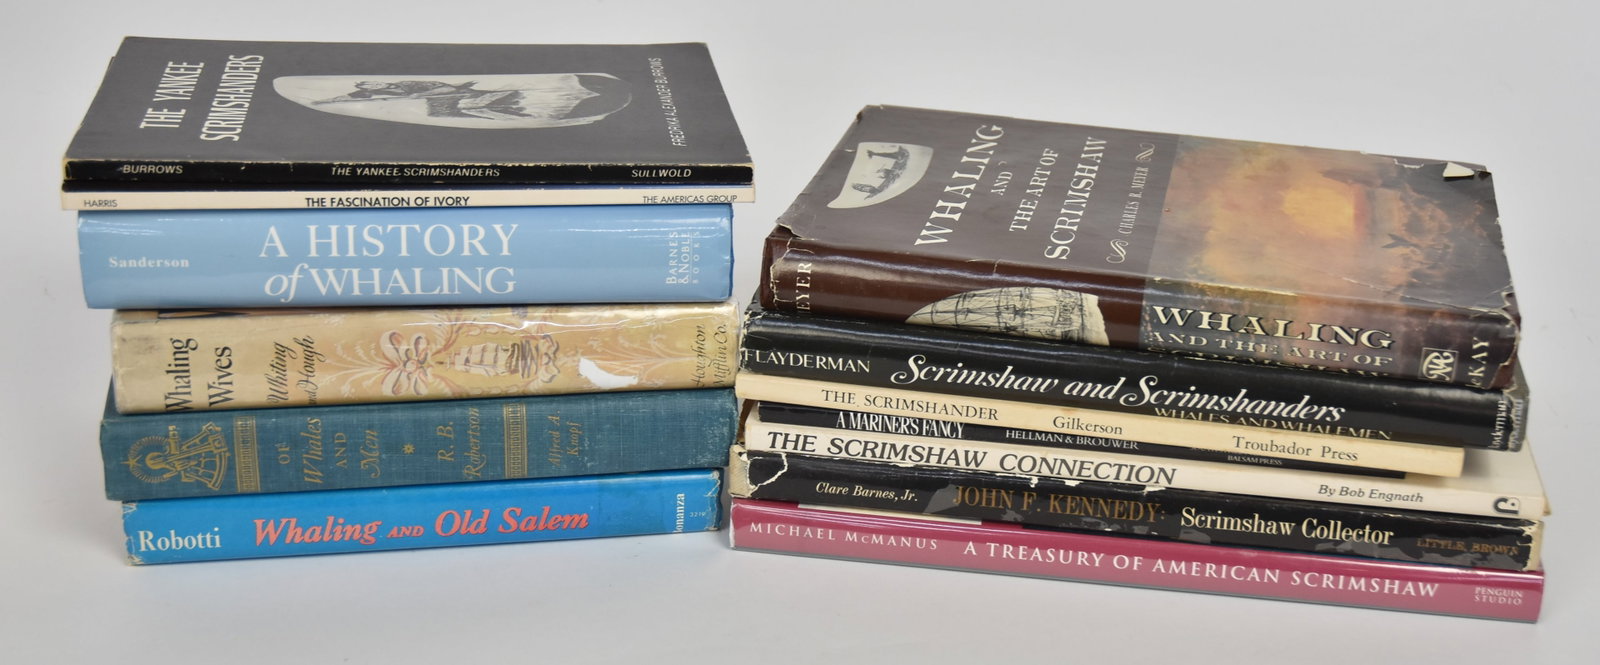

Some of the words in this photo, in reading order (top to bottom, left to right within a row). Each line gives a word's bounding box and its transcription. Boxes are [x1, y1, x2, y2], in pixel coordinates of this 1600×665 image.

[153, 61, 205, 102] YANKEE
[648, 57, 668, 84] BURROWS
[200, 55, 264, 141] SCRIMSHANDERS
[656, 85, 677, 117] ALEXANDER
[139, 107, 187, 129] THE
[666, 117, 687, 147] FREDRIKA
[121, 164, 184, 175] BURROWS
[331, 166, 353, 176] THE
[356, 167, 399, 177] YANKEE
[404, 168, 501, 178] SCRIMSHANDERS
[631, 168, 692, 178] SULLWOLD
[914, 125, 1004, 246] WHALING
[990, 171, 1013, 196] AND
[1131, 166, 1149, 190] MEYER
[83, 199, 118, 208] HARRIS
[306, 197, 327, 208] THE
[330, 197, 411, 207] FASCINATION
[414, 196, 430, 207] OF
[433, 196, 471, 207] IVORY
[642, 195, 659, 204] THE
[660, 195, 705, 204] AMERICAS
[706, 194, 738, 203] GROUP
[1009, 199, 1039, 232] THE
[1026, 167, 1051, 197] ART
[1039, 148, 1059, 166] OF
[1044, 136, 1107, 260] SCRIMSHAW
[1129, 191, 1143, 199] R.
[1118, 200, 1140, 235] CHARLES
[258, 225, 289, 258] A
[306, 224, 519, 258] HISTORY
[665, 231, 679, 285] BARNES
[108, 256, 190, 269] Sanderson
[264, 263, 308, 303] of
[309, 267, 517, 296] WHALING
[795, 262, 813, 311] EYER
[713, 323, 728, 345] Co.
[1151, 305, 1396, 349] WHALING
[292, 336, 327, 390] Hough
[690, 324, 713, 387] Houghton
[744, 349, 871, 373] FLAYDERMAN
[1149, 331, 1209, 347] AND
[1216, 337, 1280, 355] THE
[1287, 346, 1348, 363] ART
[1353, 354, 1393, 368] OF
[164, 337, 199, 412] Whaling
[208, 346, 235, 408] Wives
[264, 340, 298, 404] Whiting
[890, 354, 1059, 393] Scrimshaw
[1063, 376, 1126, 400] and
[1119, 375, 1346, 423] Scrimshanders
[436, 421, 454, 440] B.
[547, 410, 561, 427] A.
[822, 389, 856, 404] THE
[864, 394, 999, 421] SCRIMSHANDER
[1053, 415, 1123, 435] Gilkerson
[1233, 435, 1313, 457] Troubador
[1320, 446, 1358, 462] Press
[836, 411, 846, 429] A
[922, 419, 965, 439] FANCY
[1154, 407, 1231, 425] WHALES
[1236, 416, 1278, 430] AND
[1281, 420, 1393, 441] WHALEMEN
[300, 417, 324, 484] Whales
[334, 432, 348, 469] AND
[360, 428, 381, 479] Men
[437, 444, 454, 462] R.
[464, 407, 488, 480] Robertson
[547, 429, 563, 467] Alfred
[566, 420, 584, 457] Knopf
[1005, 429, 1063, 444] HELLMAN
[1065, 436, 1074, 444] &
[1076, 436, 1140, 450] BROUWER
[767, 431, 818, 454] THE
[827, 437, 988, 469] SCRIMSHAW
[1000, 453, 1177, 486] CONNECTION
[1318, 484, 1336, 497] By
[1339, 486, 1365, 498] Bob
[1368, 489, 1424, 503] Engnath
[1227, 454, 1259, 463] BALSAM
[1259, 458, 1283, 466] PRESS
[815, 481, 849, 497] Clare
[852, 484, 899, 501] Barnes,
[900, 488, 918, 502] Jr.
[253, 516, 382, 548] Whaling
[387, 525, 425, 538] AND
[435, 509, 489, 537] Old
[498, 506, 589, 533] Salem
[750, 522, 837, 541] MICHAEL
[953, 486, 1018, 507] JOHN
[1020, 491, 1042, 513] F.
[1049, 493, 1166, 522] KENNEDY:
[1181, 507, 1297, 538] Scrimshaw
[1301, 517, 1395, 545] Collector
[137, 527, 222, 552] Robotti
[1471, 542, 1520, 556] BROWN
[963, 541, 978, 557] A
[986, 542, 1103, 567] TREASURY
[1112, 554, 1143, 571] OF
[1152, 559, 1280, 583] AMERICAN
[1290, 571, 1440, 599] SCRIMSHAW
[1474, 586, 1524, 598] PENGUIN
[1474, 595, 1523, 606] STUDIO
